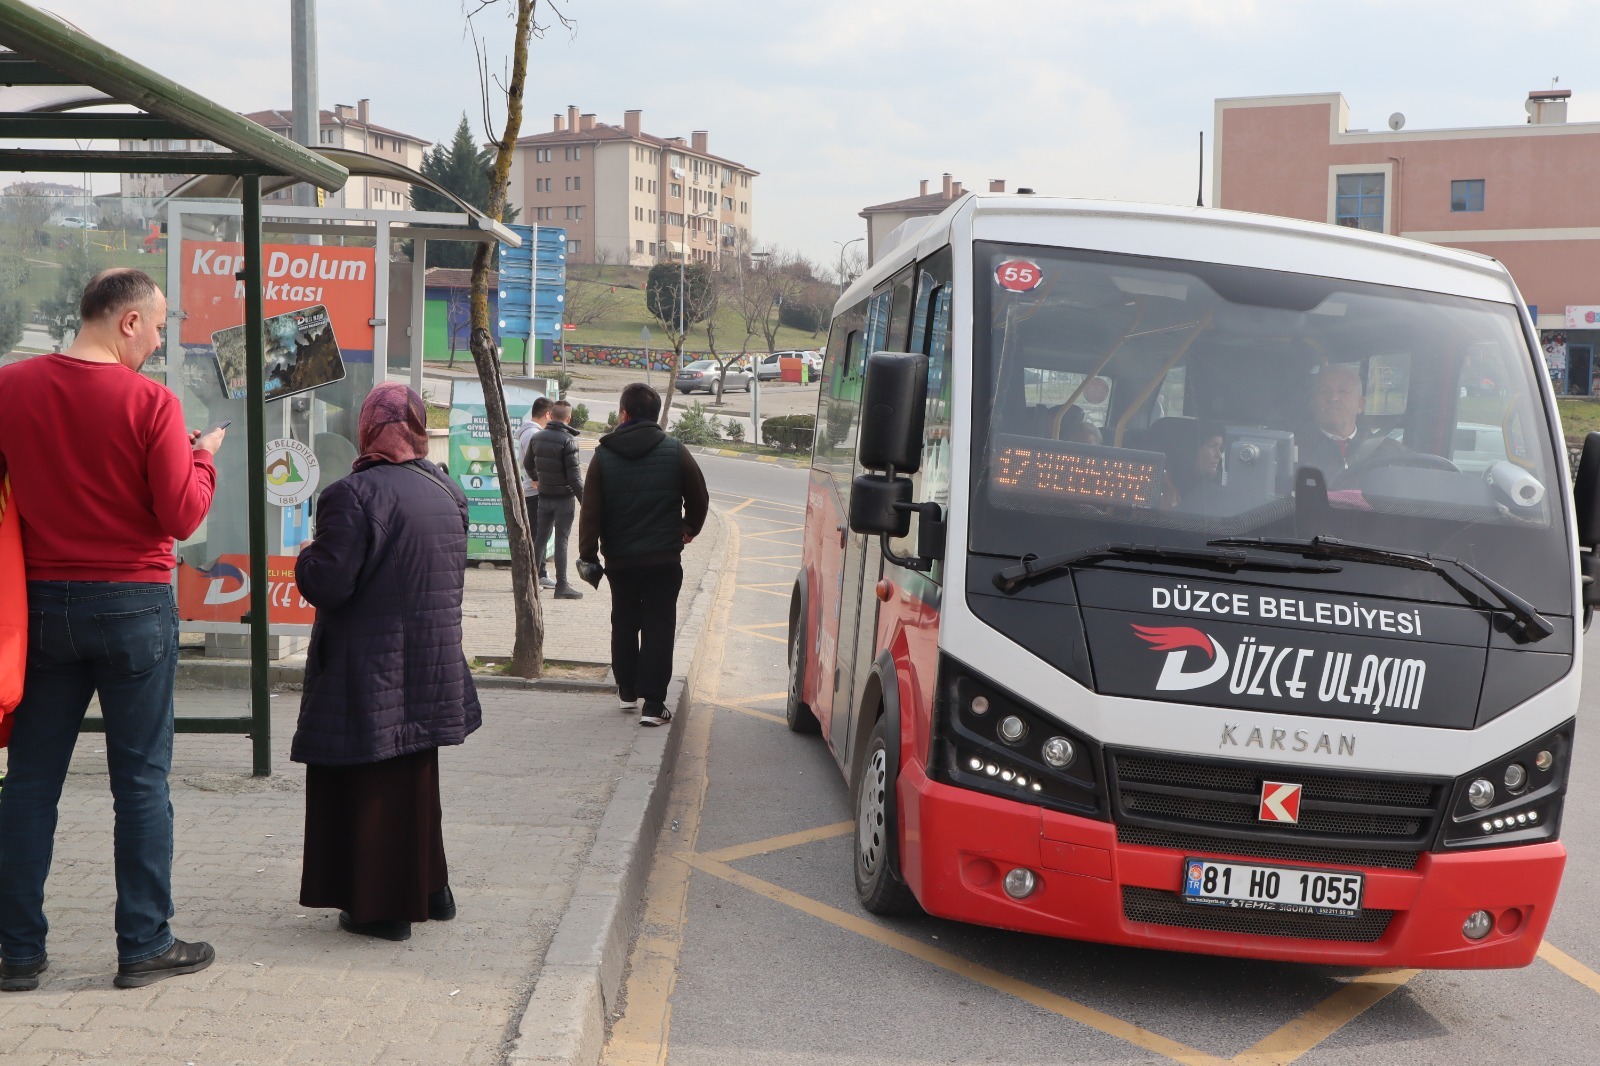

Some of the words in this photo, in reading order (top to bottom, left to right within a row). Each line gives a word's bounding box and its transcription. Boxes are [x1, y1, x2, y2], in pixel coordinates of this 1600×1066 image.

[191, 249, 246, 276] Kar
[267, 252, 367, 281] Dolum
[1004, 267, 1033, 283] 55
[279, 496, 298, 505] 1881
[1152, 584, 1250, 616] DÜZCE
[1259, 596, 1422, 636] BELEDİYESİ
[1145, 632, 1314, 700] DÜZCE
[1318, 651, 1427, 715] ULAŞIM
[1219, 722, 1357, 756] KARSAN
[1188, 880, 1200, 890] TR
[1203, 866, 1232, 896] 81
[1300, 874, 1358, 906] 1055
